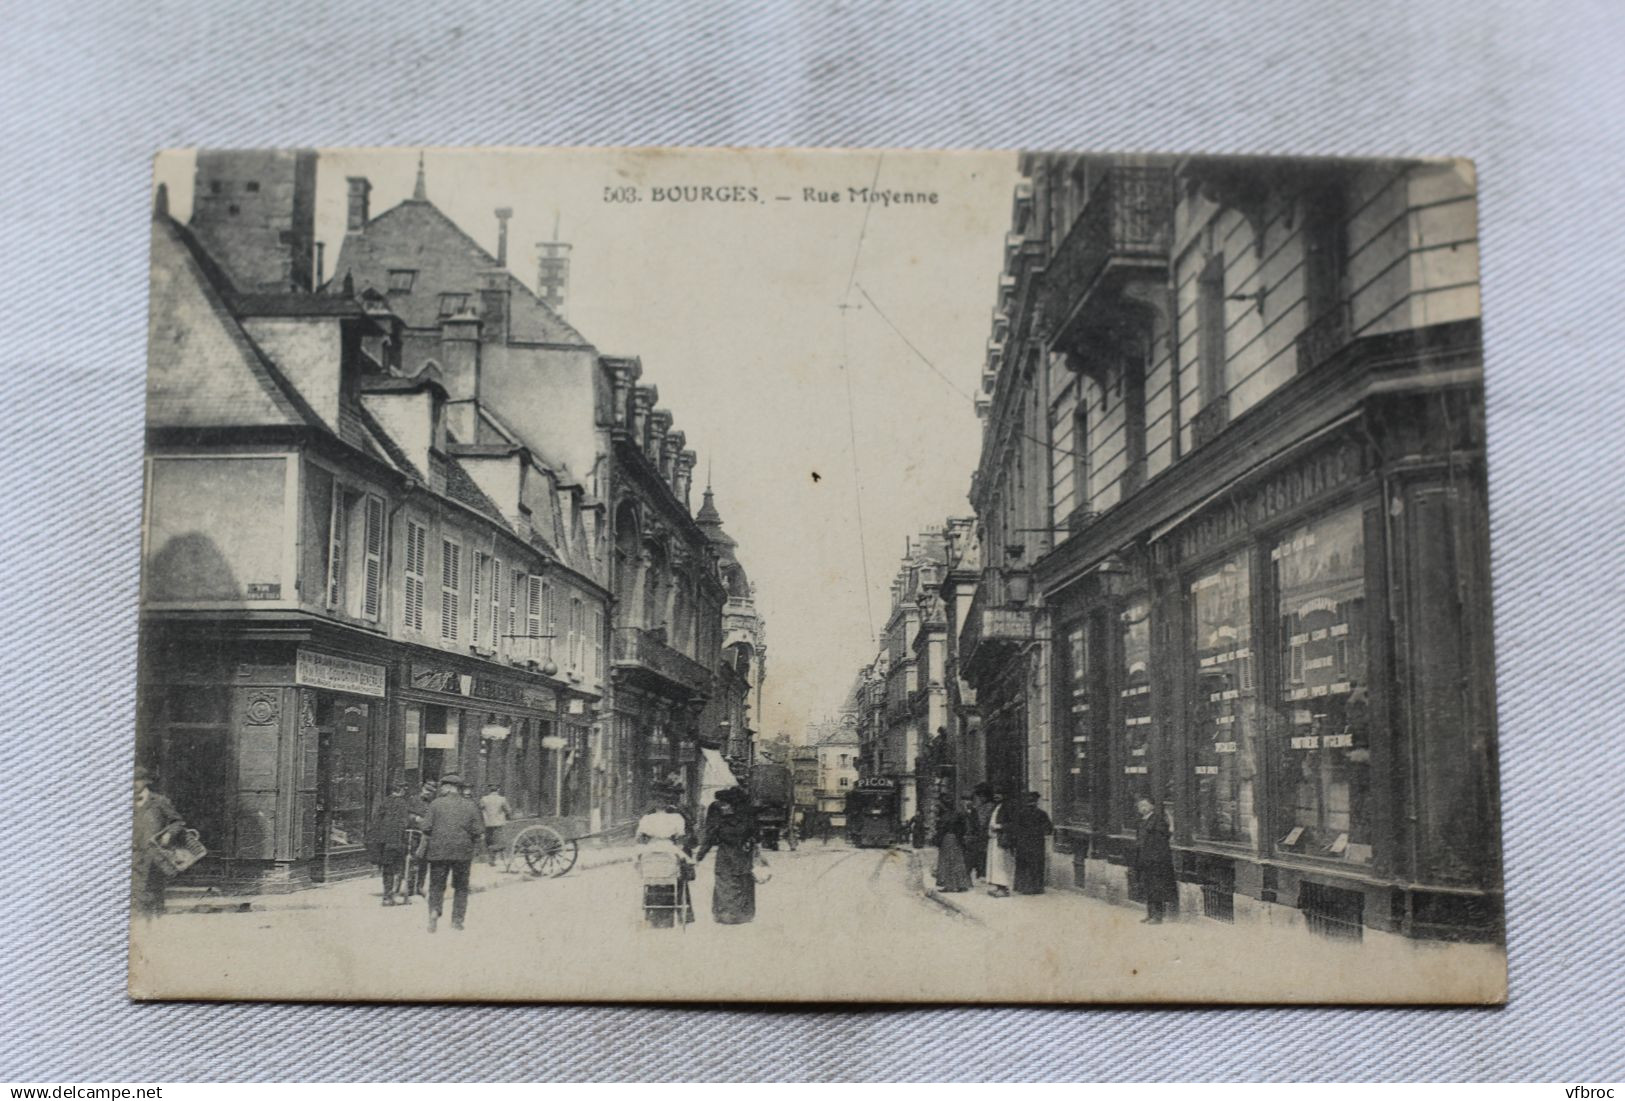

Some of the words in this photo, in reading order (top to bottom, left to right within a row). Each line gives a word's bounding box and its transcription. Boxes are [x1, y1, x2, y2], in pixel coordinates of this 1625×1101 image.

[651, 186, 765, 205] BOURGES.
[803, 187, 840, 203] Rue
[847, 187, 939, 207] Moyenne
[857, 777, 894, 787] PICON
